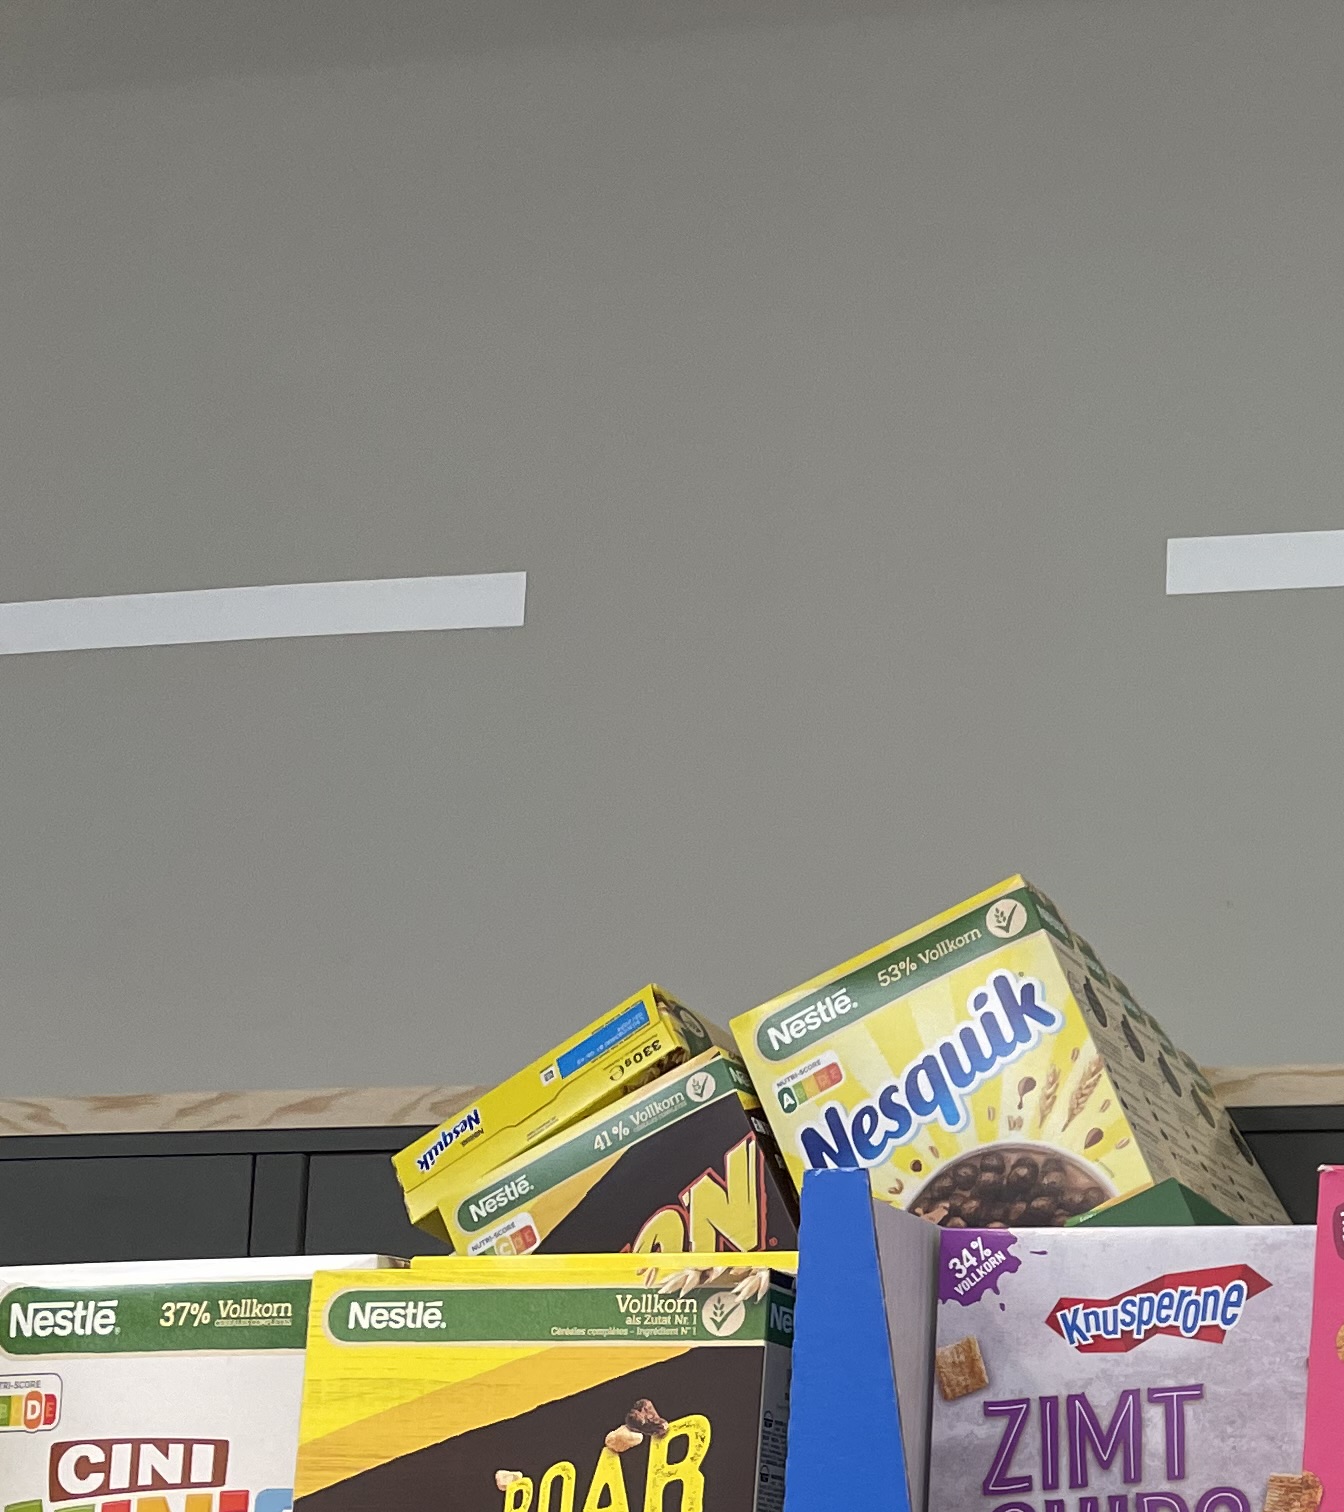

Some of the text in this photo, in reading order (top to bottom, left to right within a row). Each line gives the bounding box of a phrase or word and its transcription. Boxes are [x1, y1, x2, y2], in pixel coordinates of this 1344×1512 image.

[877, 927, 982, 987] 53% Vollkorn
[767, 988, 858, 1051] Nestlé
[799, 971, 1057, 1168] Nesquik
[629, 1090, 686, 1126] Vollkorn
[415, 1108, 482, 1173] Nesquik
[468, 1174, 534, 1223] Nestlé
[633, 1134, 764, 1253] ON
[948, 1236, 993, 1280] 34%
[953, 1249, 1007, 1298] VOLLKORN
[9, 1300, 119, 1338] Nestlé
[159, 1298, 293, 1327] 37% Vollkorn
[348, 1301, 447, 1330] Nestlé
[615, 1294, 697, 1315] Vollkorn
[625, 1315, 642, 1326] als
[643, 1315, 672, 1326] Zutat
[1059, 1279, 1248, 1347] Knusperone
[982, 1383, 1204, 1497] ZIMT
[57, 1442, 215, 1495] CINI
